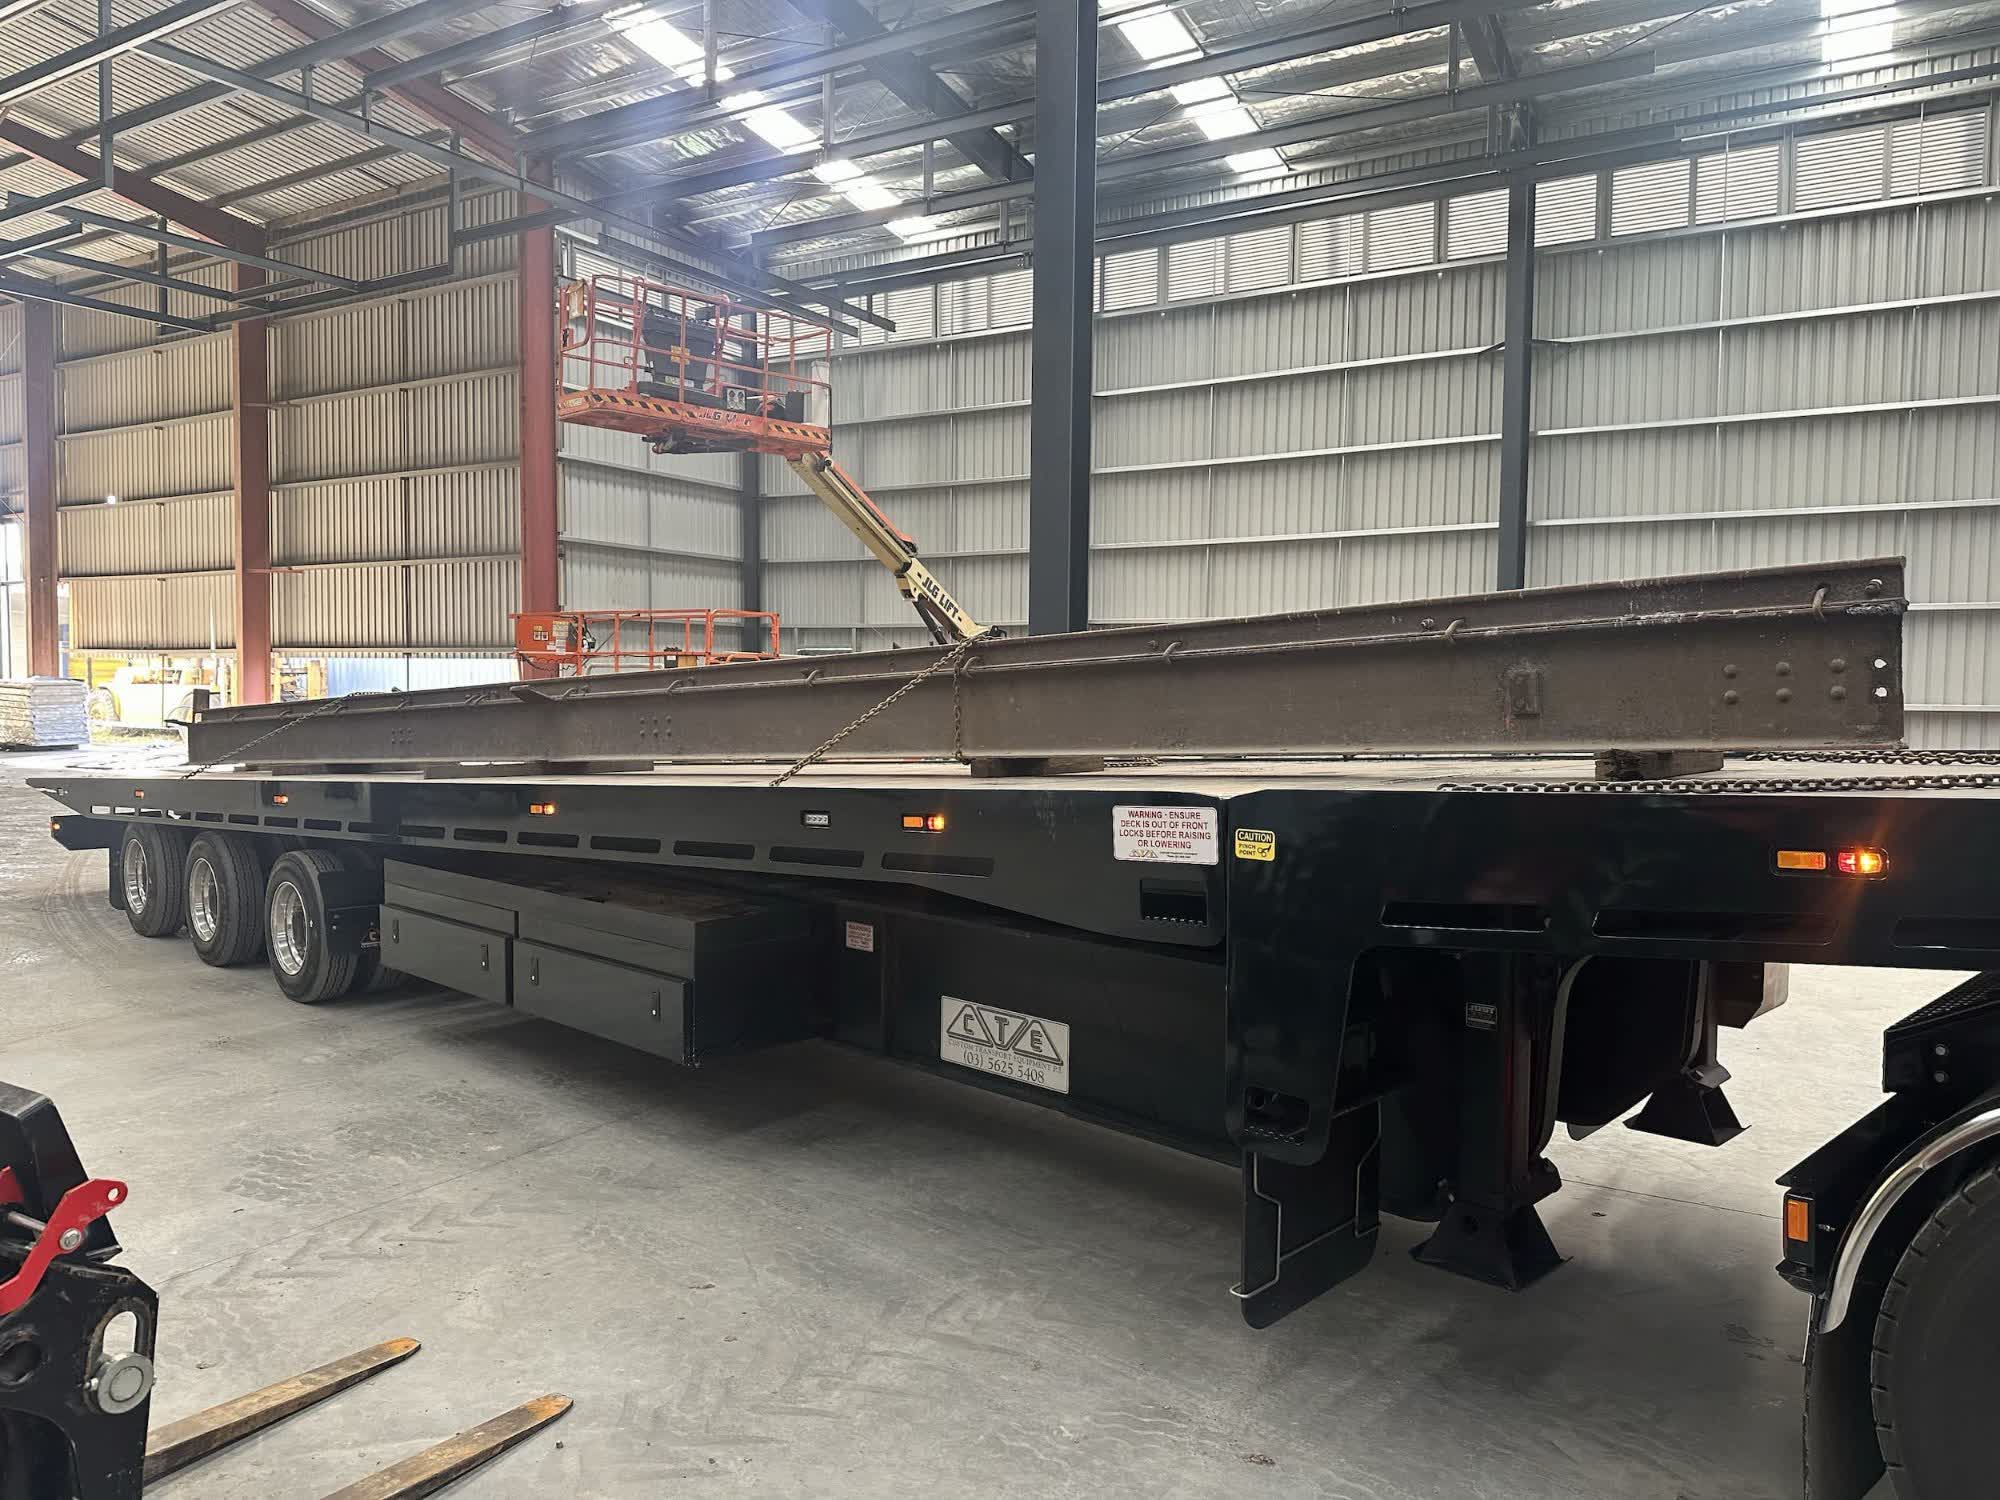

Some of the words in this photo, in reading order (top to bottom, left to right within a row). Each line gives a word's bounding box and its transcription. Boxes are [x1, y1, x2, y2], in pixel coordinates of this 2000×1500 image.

[921, 577, 940, 599] JLG
[938, 594, 959, 618] LIFT
[1128, 810, 1162, 819] WARNING
[1169, 811, 1201, 820] ENSURE
[1120, 820, 1141, 828] DECK
[1142, 820, 1150, 828] IS
[1151, 821, 1167, 829] OUT
[1169, 821, 1179, 829] OF
[1181, 821, 1208, 830] FRONT
[1119, 829, 1144, 838] LOCKS
[1145, 830, 1177, 839] BEFORE
[1179, 831, 1211, 840] RAISING
[1238, 831, 1272, 843] CAUTION
[1137, 839, 1149, 848] OR
[1150, 840, 1192, 849] LOWERING
[963, 1050, 984, 1067] (03)
[988, 1057, 1014, 1076] 5625
[1017, 1065, 1045, 1084] 5408
